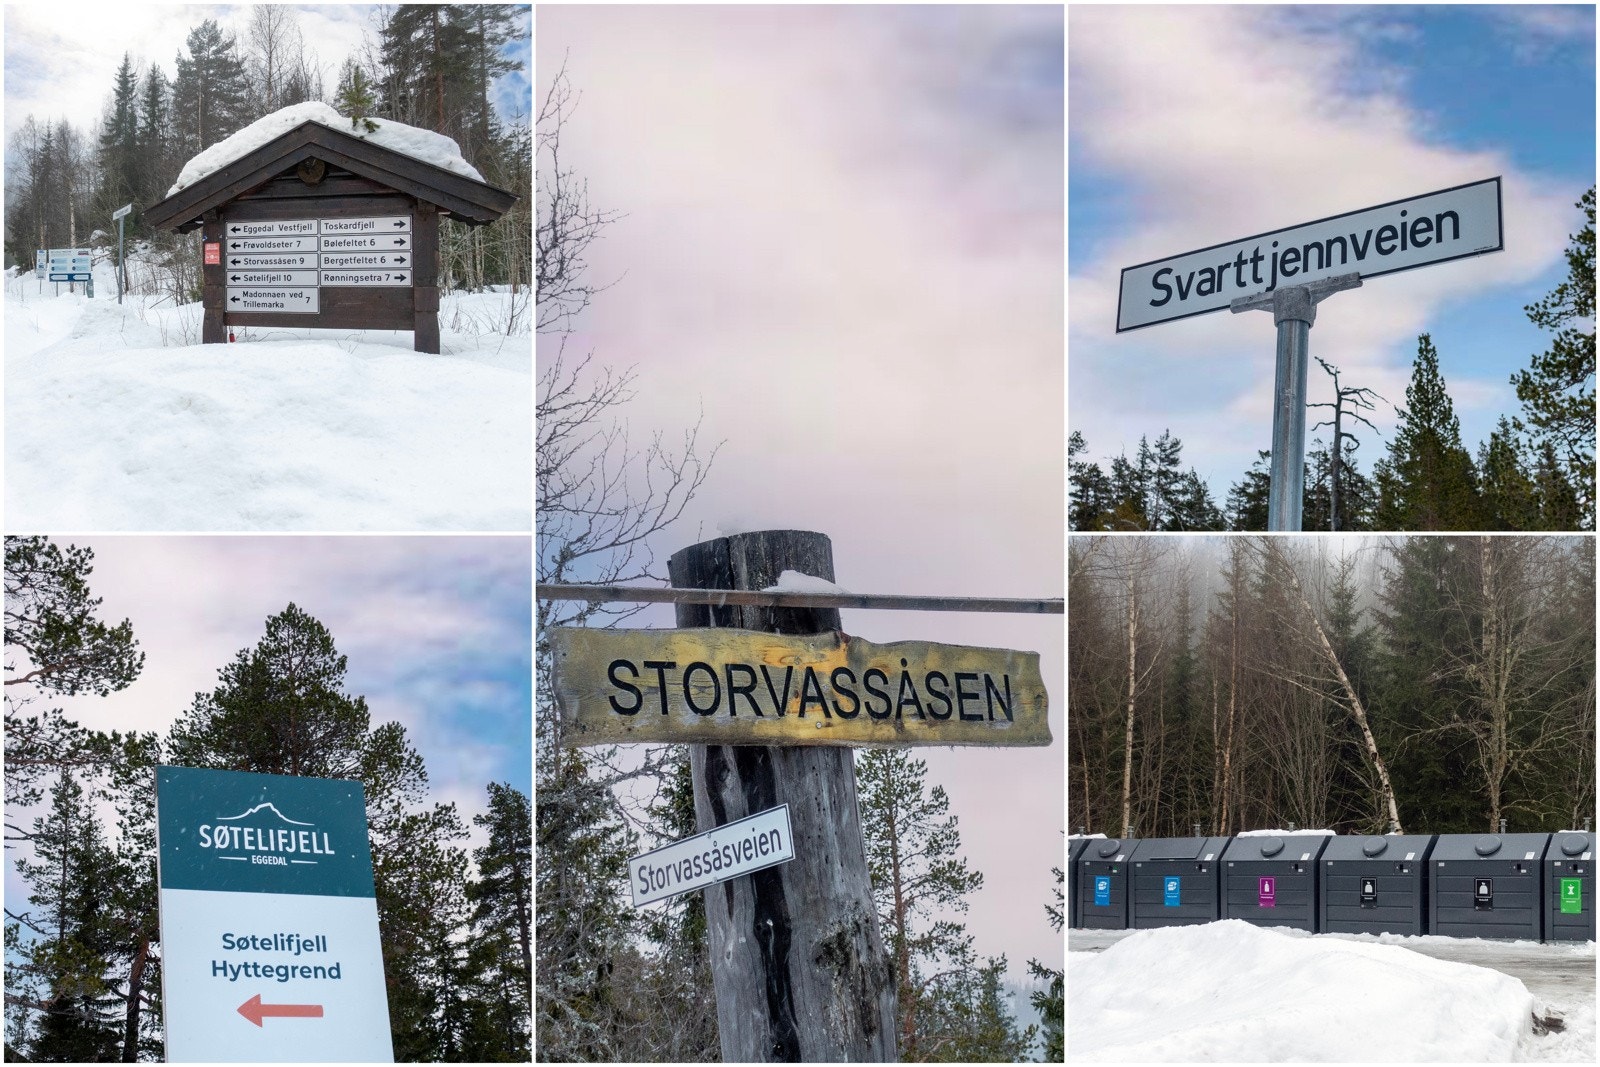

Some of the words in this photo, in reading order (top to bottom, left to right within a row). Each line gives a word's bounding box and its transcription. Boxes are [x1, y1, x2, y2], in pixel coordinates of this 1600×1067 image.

[243, 225, 274, 234] Eggedal
[278, 223, 313, 233] Vestfjell
[324, 221, 375, 231] Toskardfjell
[243, 241, 293, 249] Frøvoldseter
[296, 240, 301, 248] 7
[324, 239, 367, 247] Bølefeltet
[369, 238, 376, 246] 6
[243, 257, 297, 265] Storvassåsen
[299, 257, 305, 265] 9
[324, 256, 377, 266] Bergetfeltet
[380, 255, 386, 264] 6
[1149, 209, 1461, 307] Svarttjennveien
[243, 274, 281, 283] Søtelifjell
[283, 274, 292, 282] 10
[324, 274, 382, 283] Rønningsetra
[384, 273, 391, 281] 7
[305, 296, 311, 304] 7
[607, 657, 1015, 722] STORVASSÅSEN
[199, 824, 335, 855] SØTELIFJELL
[251, 855, 288, 866] EGGEDAL
[638, 827, 782, 895] Storvassåsveien
[222, 933, 327, 956] Søtelifjell
[211, 960, 342, 982] Hyttegrend
